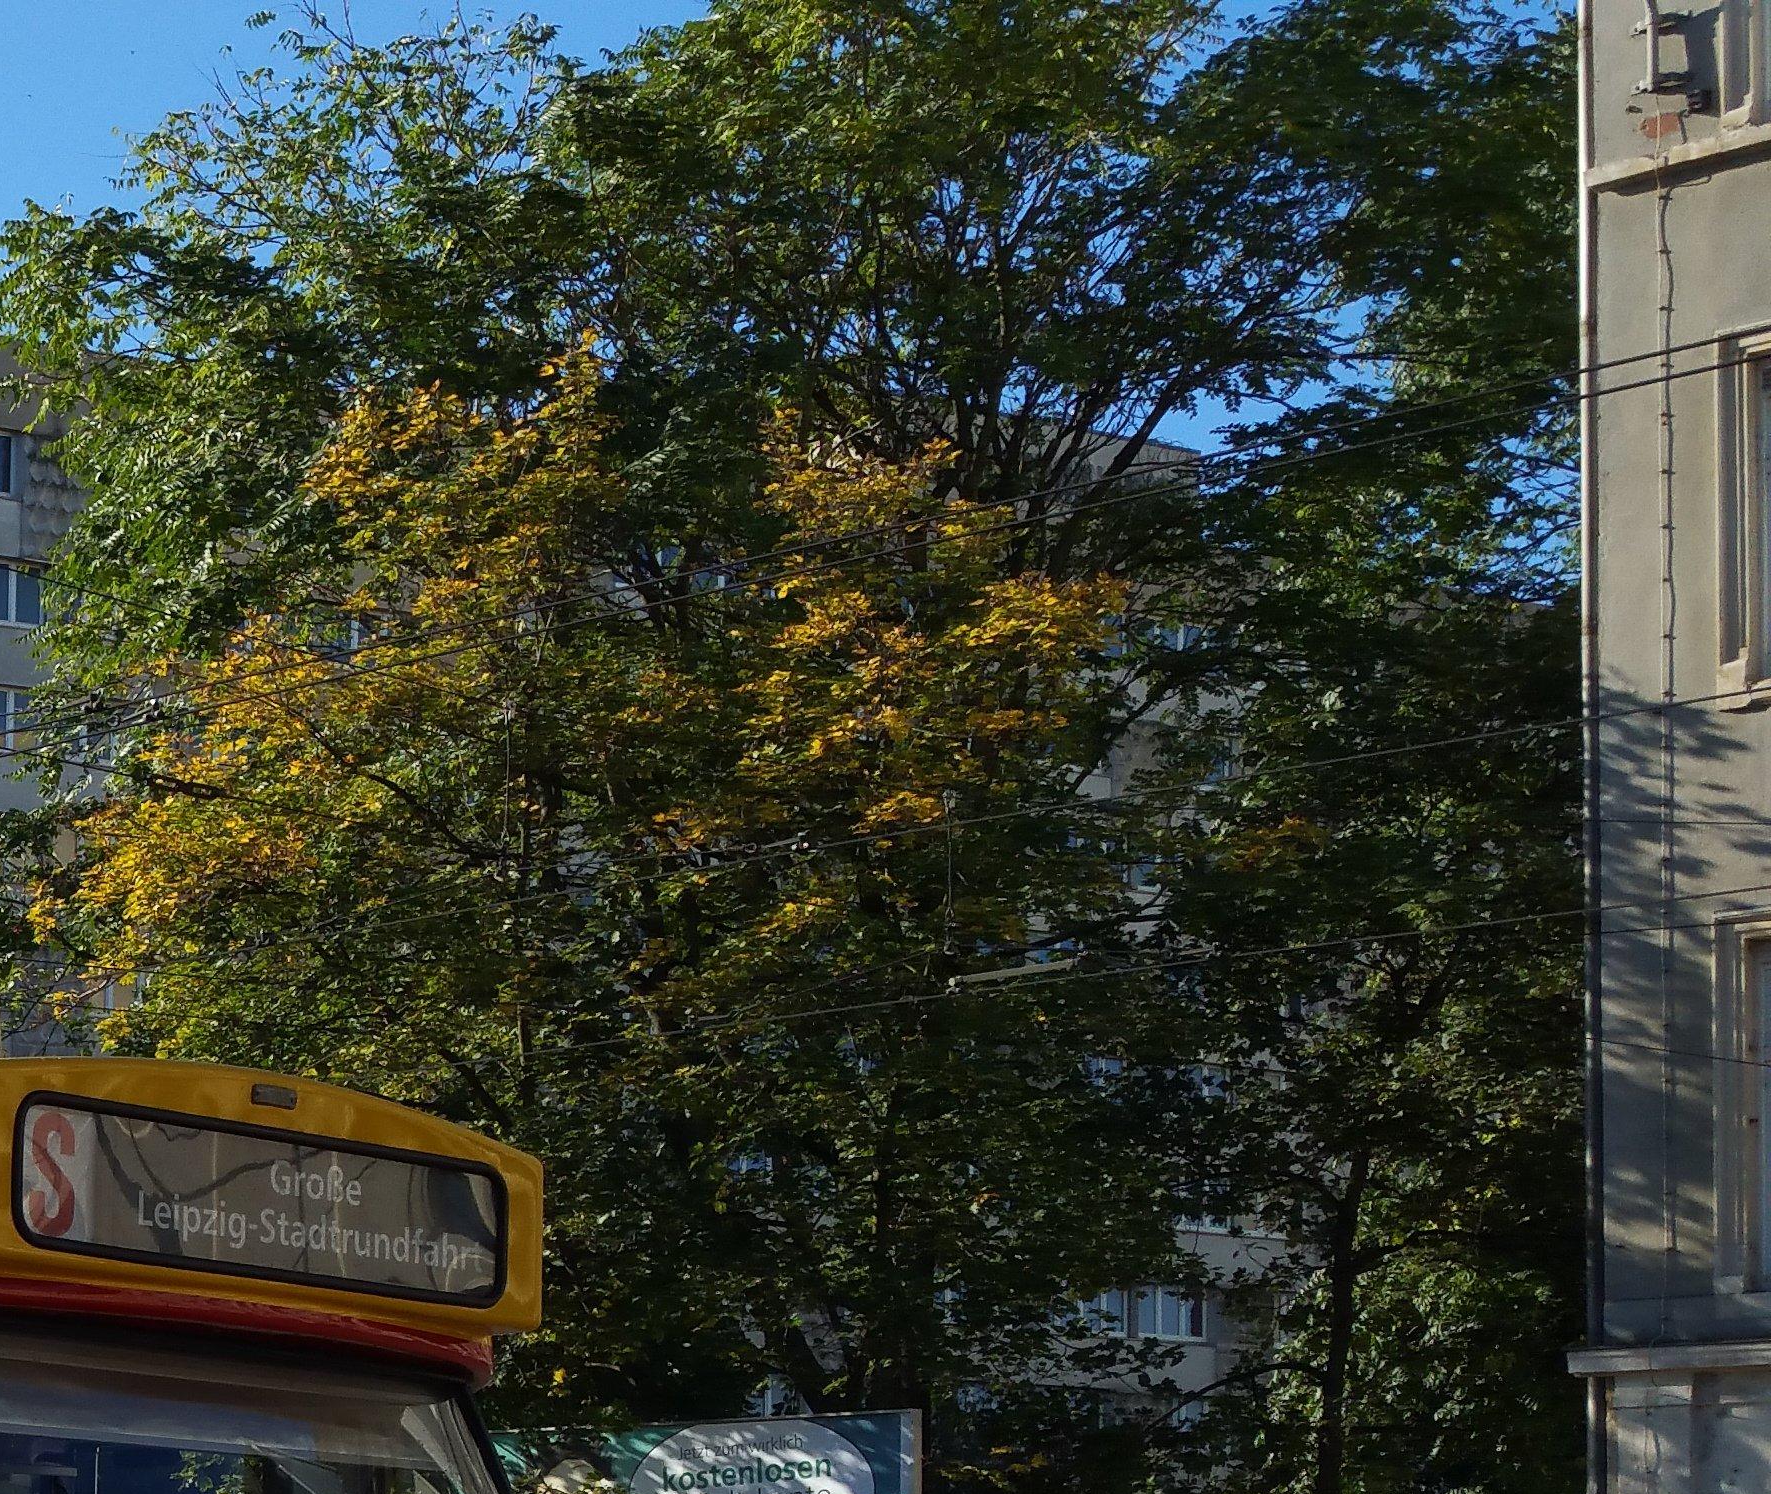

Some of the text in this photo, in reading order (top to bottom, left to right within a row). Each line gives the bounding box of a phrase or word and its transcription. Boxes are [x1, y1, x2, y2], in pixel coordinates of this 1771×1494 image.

[27, 1111, 76, 1237] S
[270, 1158, 363, 1207] Große
[138, 1190, 485, 1274] Leipzig-Stadtrundfahrt
[715, 1444, 746, 1458] zum
[748, 1434, 803, 1454] wirklich
[662, 1458, 832, 1491] kostenlosen
